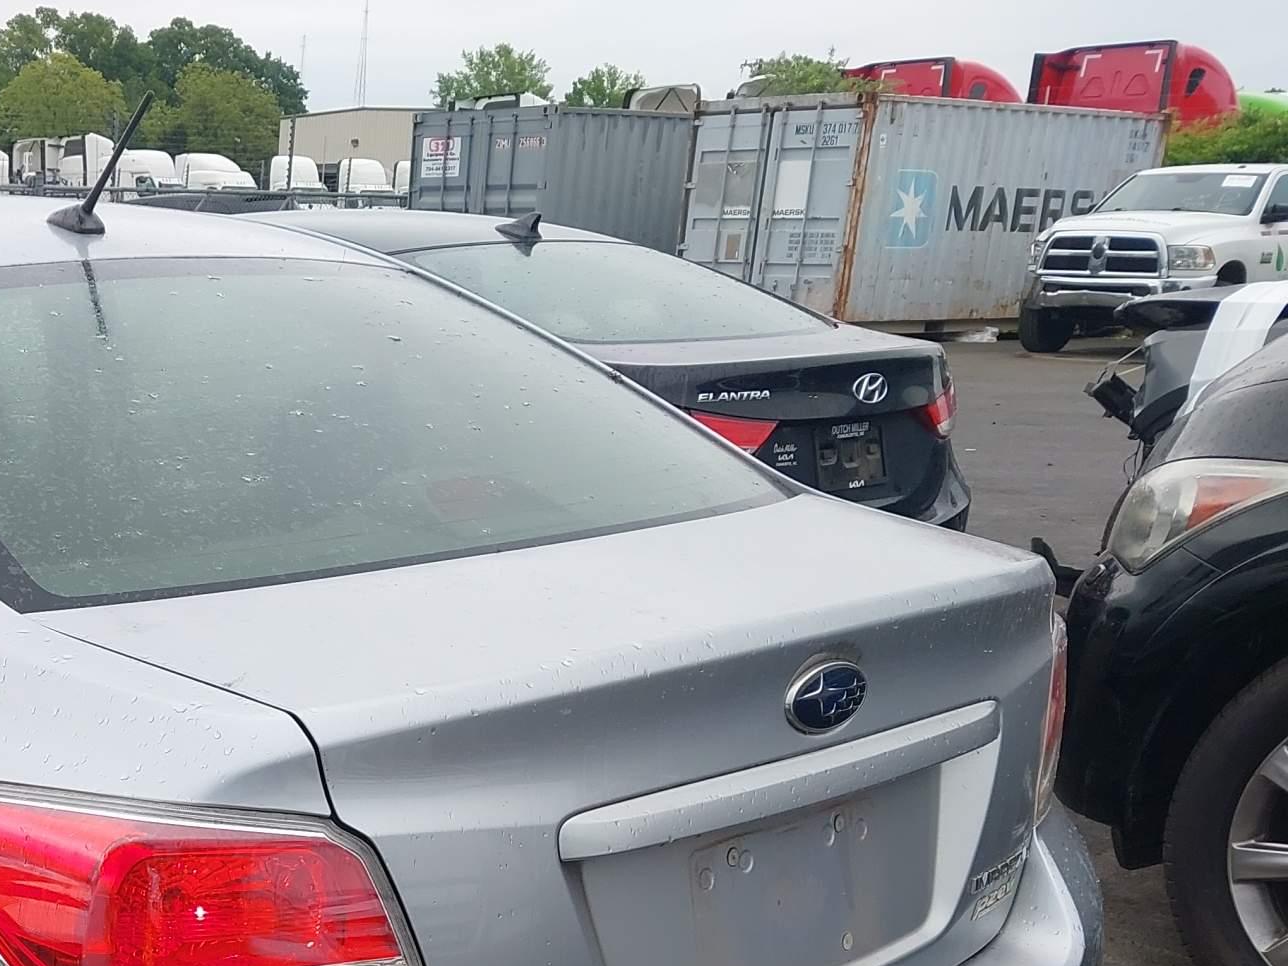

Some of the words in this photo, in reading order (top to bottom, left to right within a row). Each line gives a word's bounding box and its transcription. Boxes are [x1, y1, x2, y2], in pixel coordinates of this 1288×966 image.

[772, 208, 805, 216] MAERSK
[945, 185, 1109, 232] MAERS
[697, 390, 770, 403] ELANTRA
